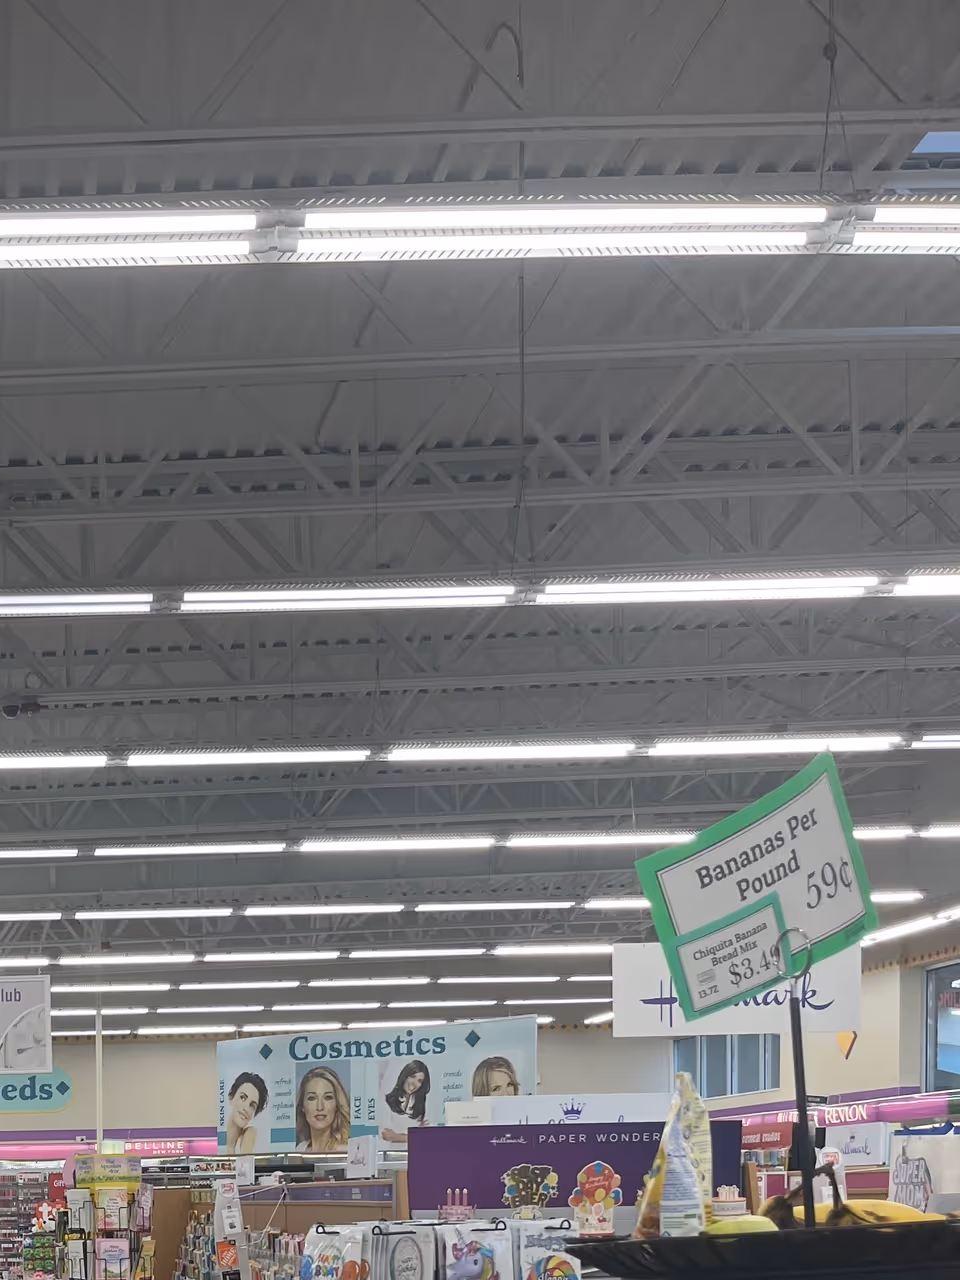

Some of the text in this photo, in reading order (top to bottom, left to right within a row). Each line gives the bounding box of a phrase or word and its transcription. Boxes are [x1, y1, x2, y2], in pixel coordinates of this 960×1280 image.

[695, 809, 818, 889] Bananas Per
[735, 849, 801, 902] Pound
[806, 856, 853, 910] 59¢
[692, 922, 768, 961] Chiquita Banana
[711, 940, 758, 968] Bread Mix
[289, 1029, 447, 1062] Cosmetics
[354, 1096, 362, 1119] FACE
[368, 1097, 376, 1121] EYES
[824, 1104, 869, 1125] REVLON
[488, 1135, 528, 1145] Hallmark
[538, 1134, 588, 1144] PAPER
[841, 1137, 871, 1155] allmark
[895, 1159, 926, 1185] SUPER
[894, 1185, 926, 1207] MOM
